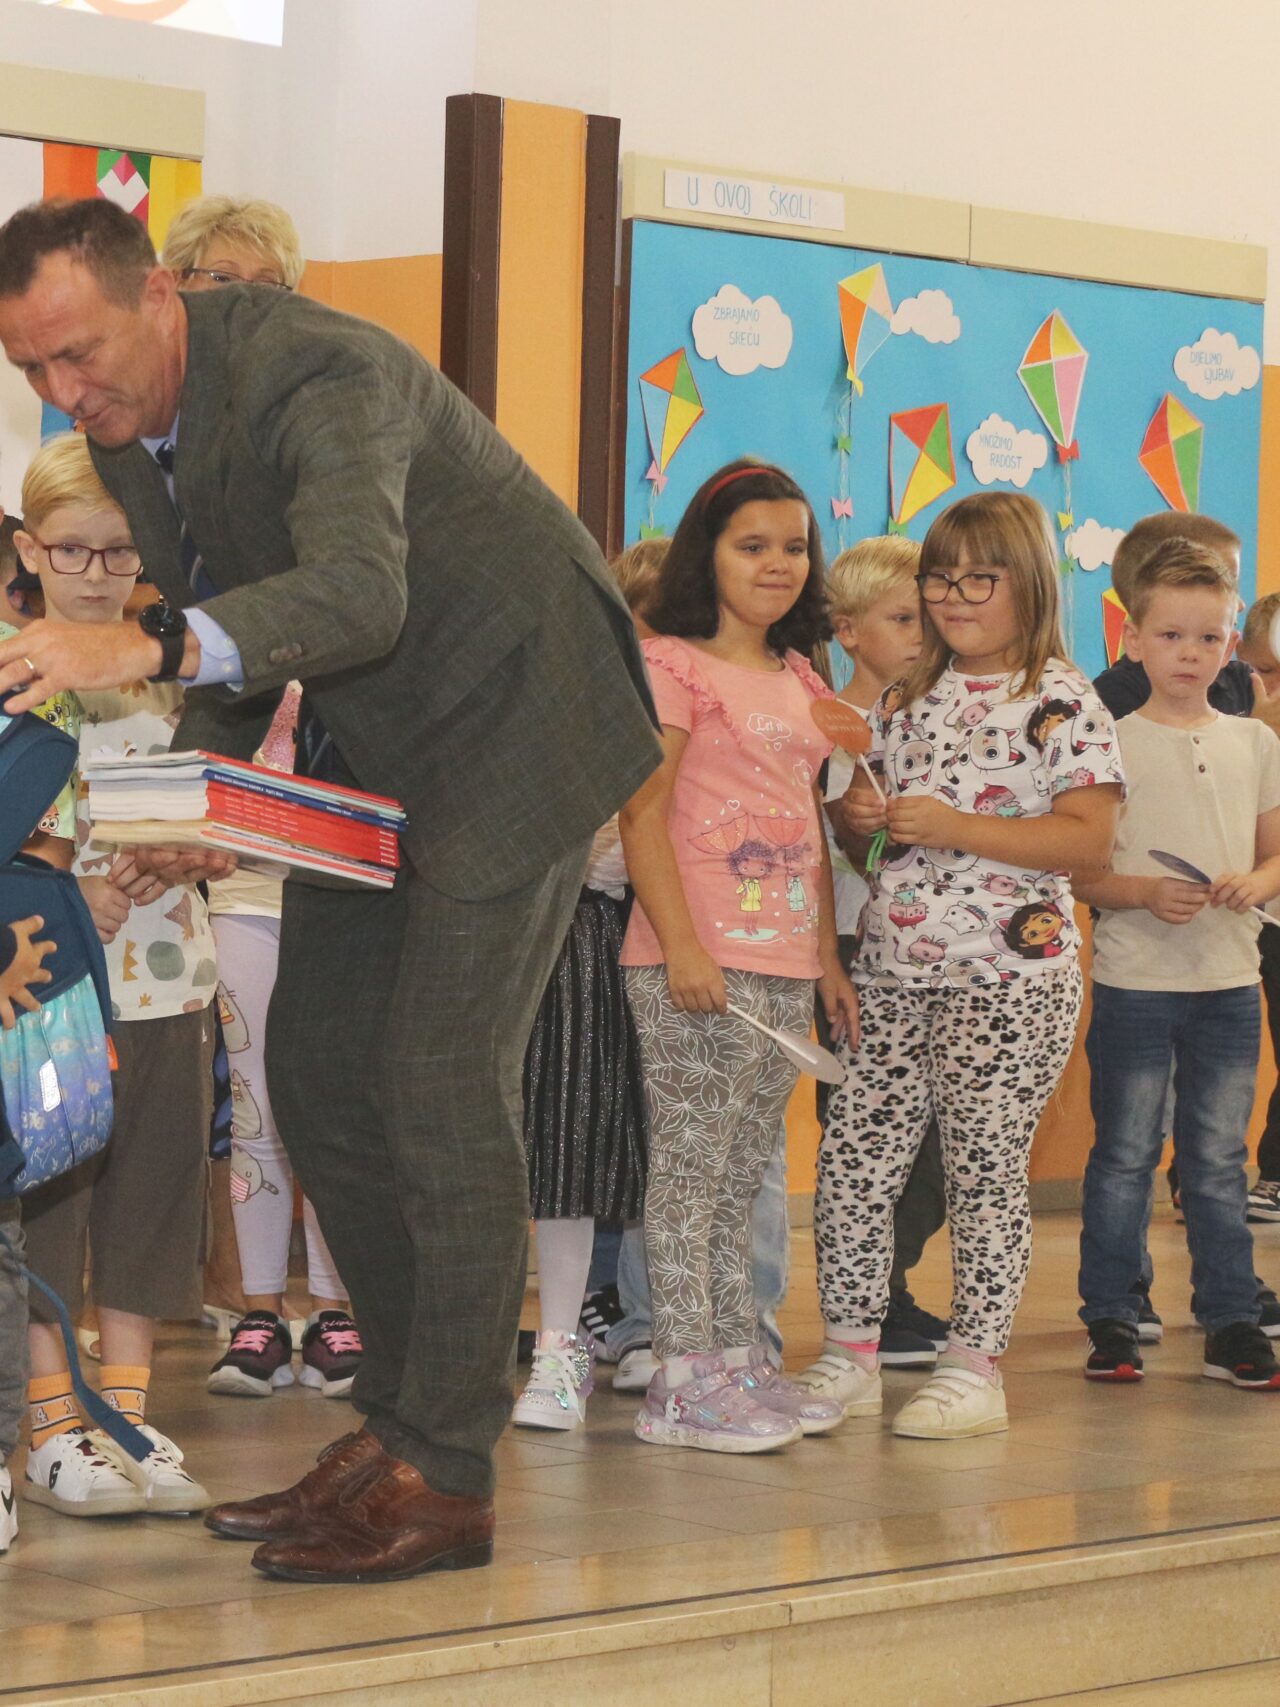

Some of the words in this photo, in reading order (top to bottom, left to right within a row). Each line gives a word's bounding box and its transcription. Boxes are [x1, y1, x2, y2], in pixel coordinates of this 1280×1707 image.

[687, 176, 699, 207] U
[714, 181, 751, 216] OVOJ
[713, 306, 760, 325] ZBRAJAMO
[990, 452, 1023, 469] RADOST
